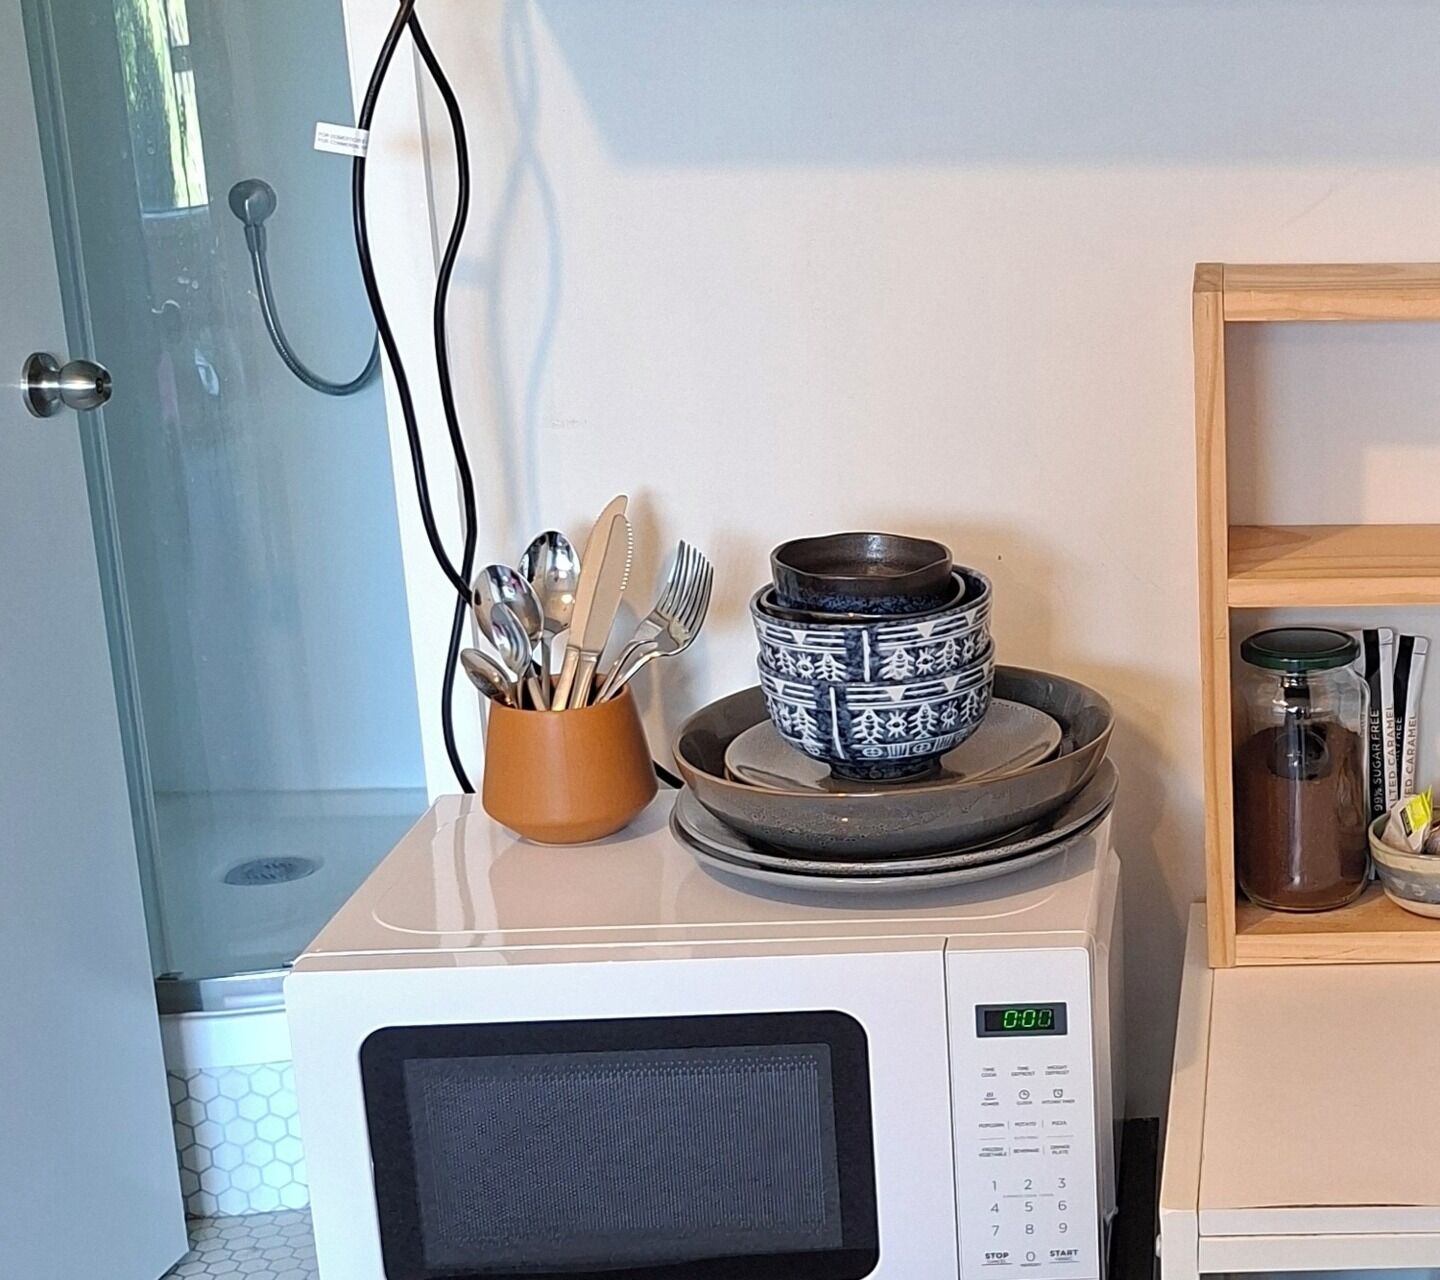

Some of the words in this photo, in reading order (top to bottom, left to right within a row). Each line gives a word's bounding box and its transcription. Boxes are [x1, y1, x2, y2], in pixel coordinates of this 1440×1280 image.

[1369, 708, 1381, 740] FREE
[1385, 704, 1396, 766] CARAMEL
[1405, 714, 1417, 775] CARAMEL
[1371, 742, 1382, 784] SUGAR
[1373, 786, 1384, 812] 99%
[1003, 1009, 1052, 1028] 0:00
[991, 1180, 997, 1192] 1
[1024, 1179, 1032, 1190] 2
[1057, 1177, 1066, 1189] 3
[990, 1203, 999, 1213] 4
[1024, 1201, 1033, 1212] 5
[1058, 1200, 1067, 1211] 6
[991, 1225, 1000, 1236] 7
[1025, 1224, 1034, 1235] 8
[1058, 1222, 1068, 1233] 9
[1026, 1251, 1036, 1262] 0
